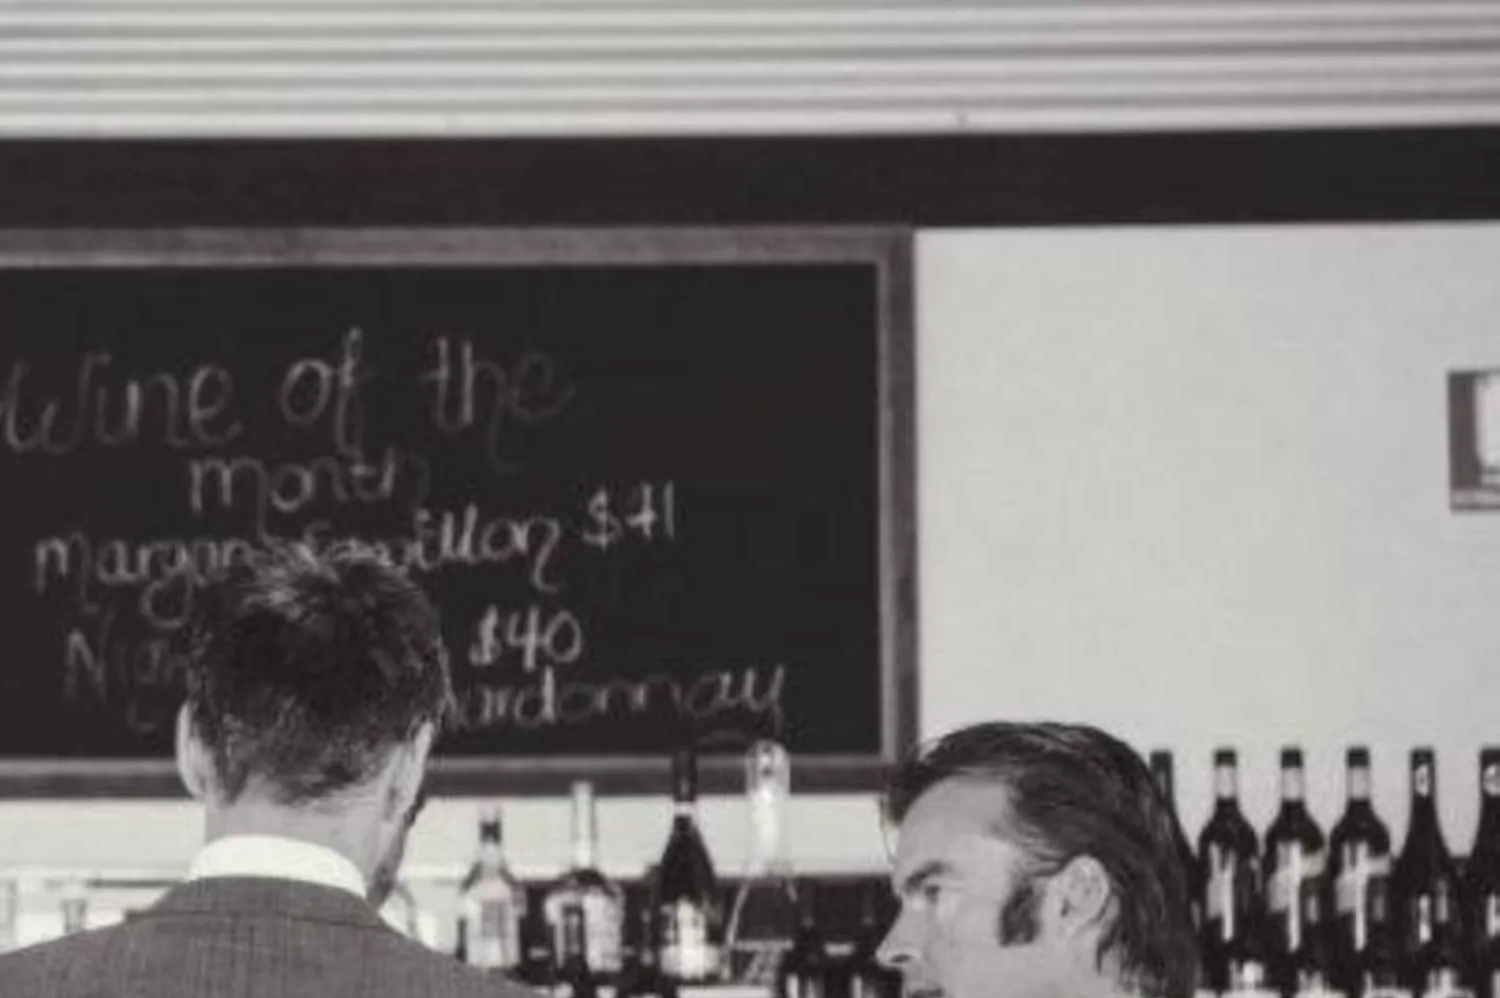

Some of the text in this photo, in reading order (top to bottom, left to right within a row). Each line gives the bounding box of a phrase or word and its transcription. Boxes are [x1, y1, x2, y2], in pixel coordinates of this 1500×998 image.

[280, 325, 372, 460] of
[420, 335, 577, 472] the
[467, 603, 582, 672] $40
